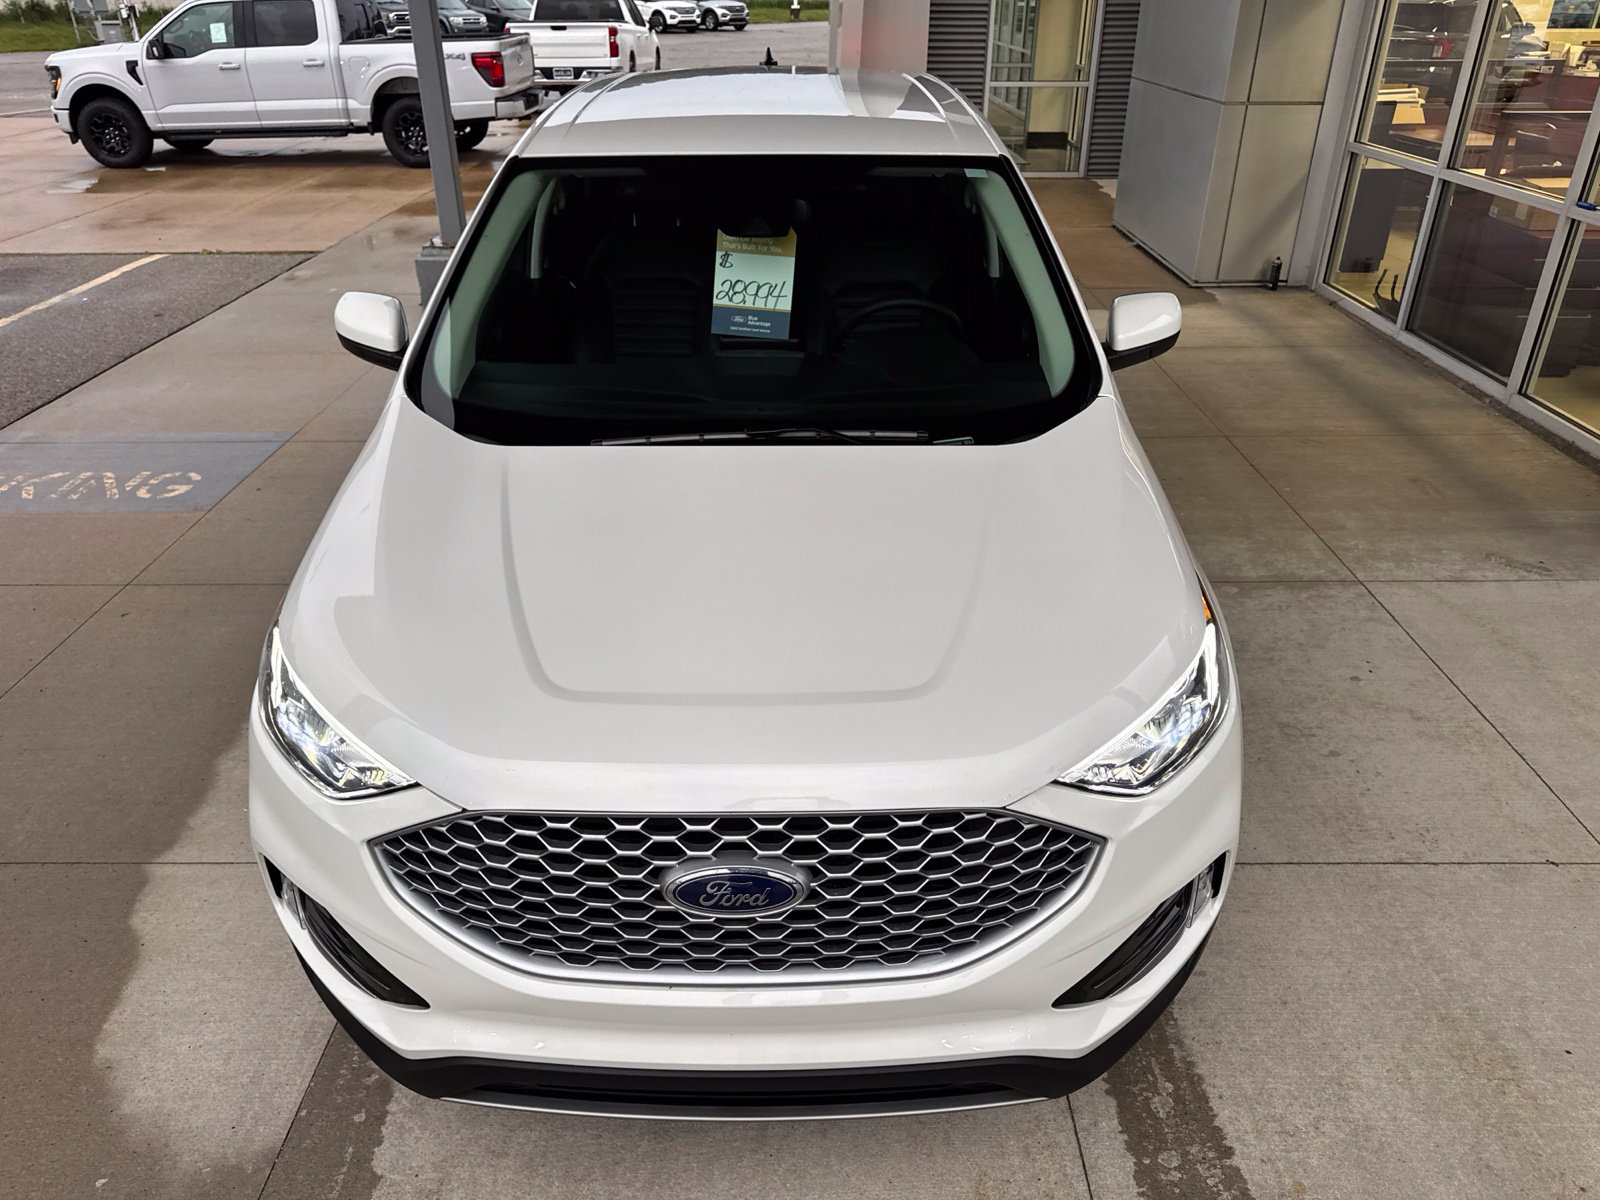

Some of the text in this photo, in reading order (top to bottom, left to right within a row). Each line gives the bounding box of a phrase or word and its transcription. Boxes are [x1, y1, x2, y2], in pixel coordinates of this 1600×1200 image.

[742, 242, 757, 250] Built
[719, 250, 733, 268] $
[698, 880, 771, 907] Ford
